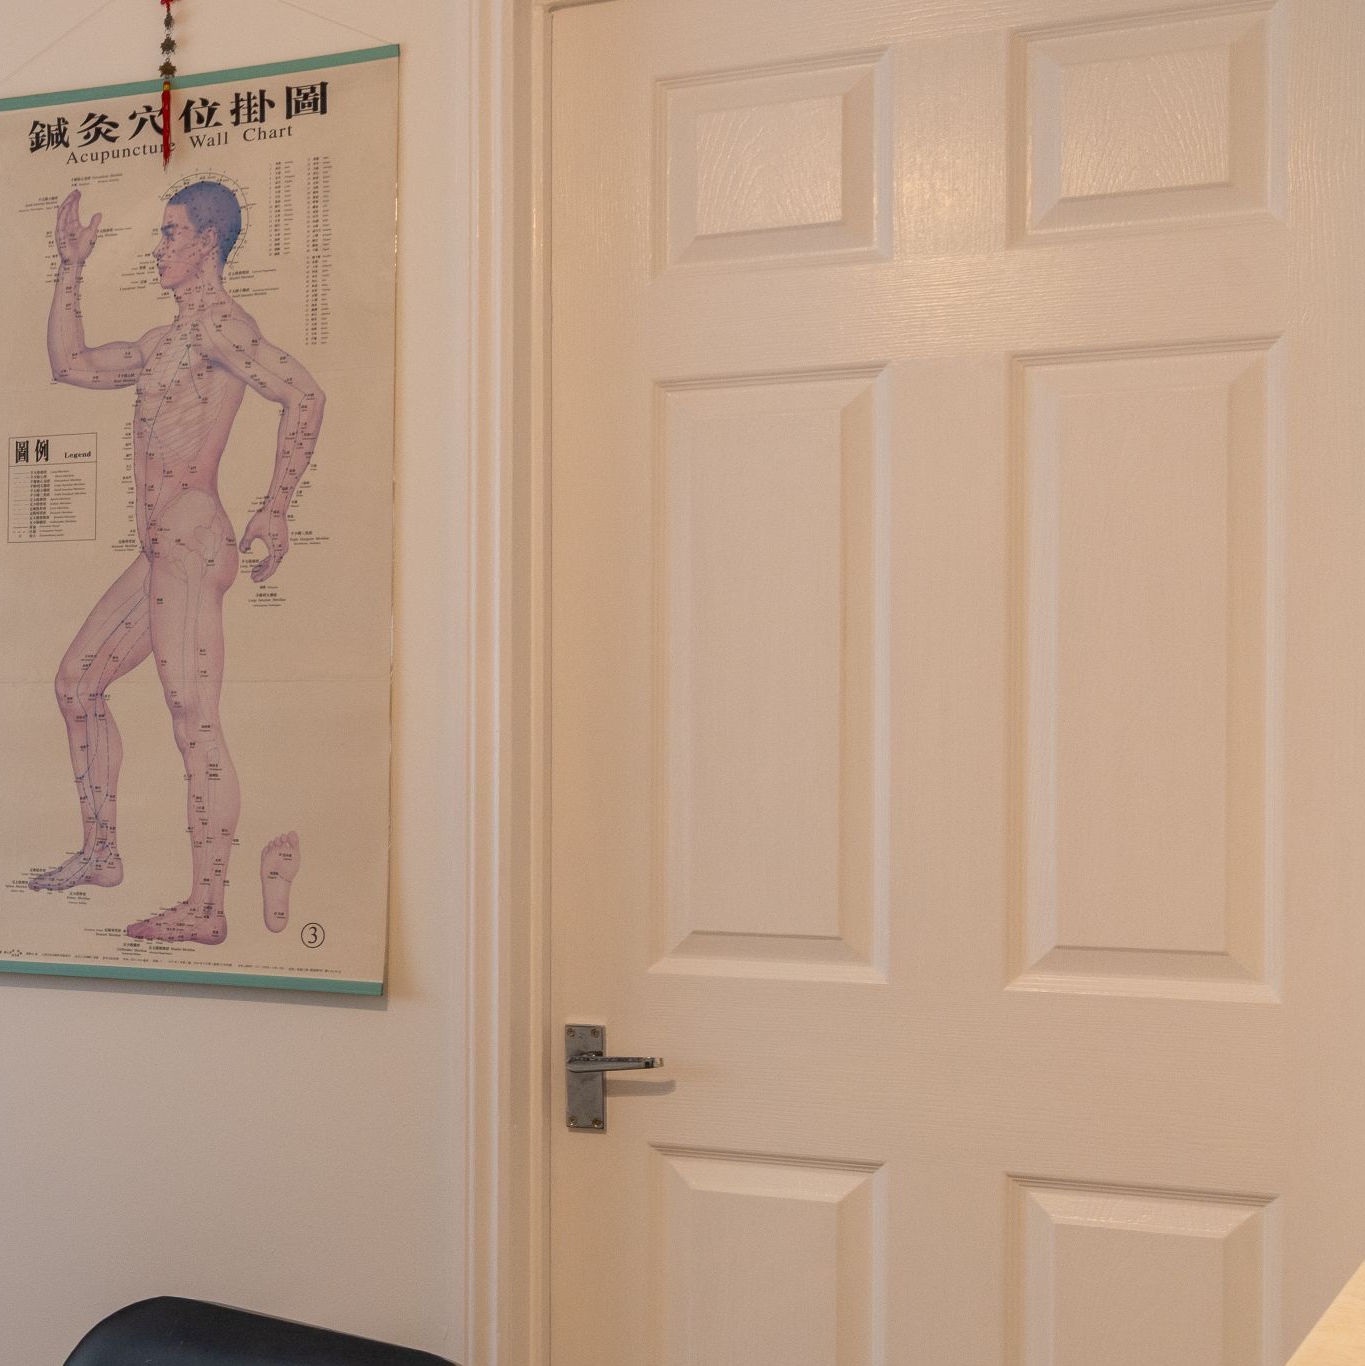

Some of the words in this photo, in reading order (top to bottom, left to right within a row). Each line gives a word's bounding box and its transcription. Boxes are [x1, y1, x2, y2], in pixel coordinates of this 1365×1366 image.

[190, 132, 228, 148] Wall
[243, 125, 293, 142] Chart
[16, 439, 49, 463] 圖例
